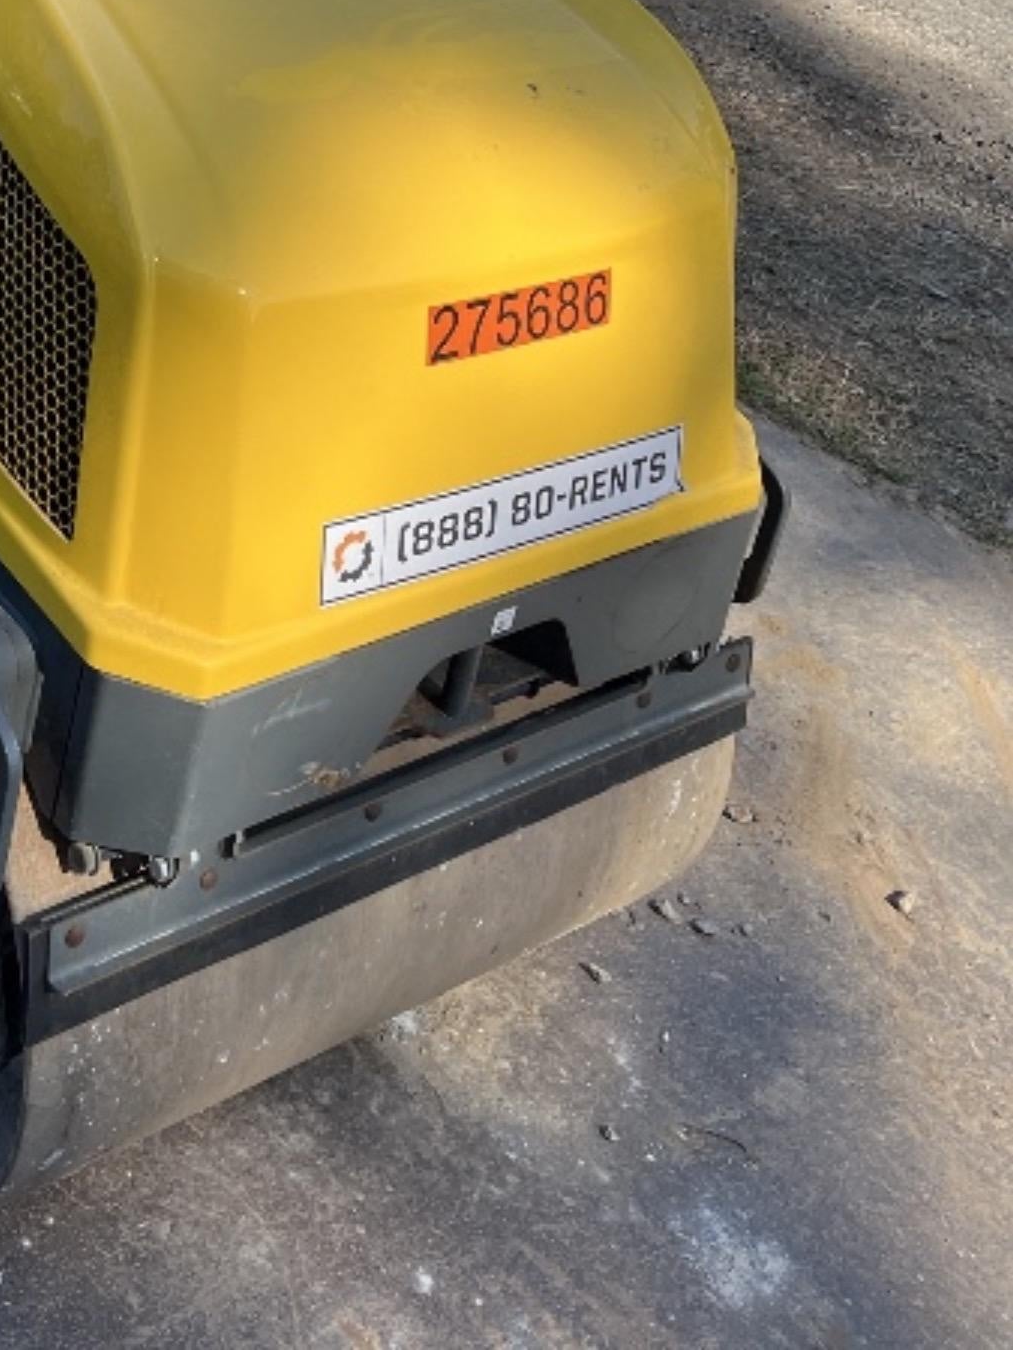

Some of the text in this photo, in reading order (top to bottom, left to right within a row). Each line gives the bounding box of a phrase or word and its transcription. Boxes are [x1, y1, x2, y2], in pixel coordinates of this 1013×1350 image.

[429, 274, 608, 364] 275686
[398, 452, 667, 563] (888) 80-RENTS
